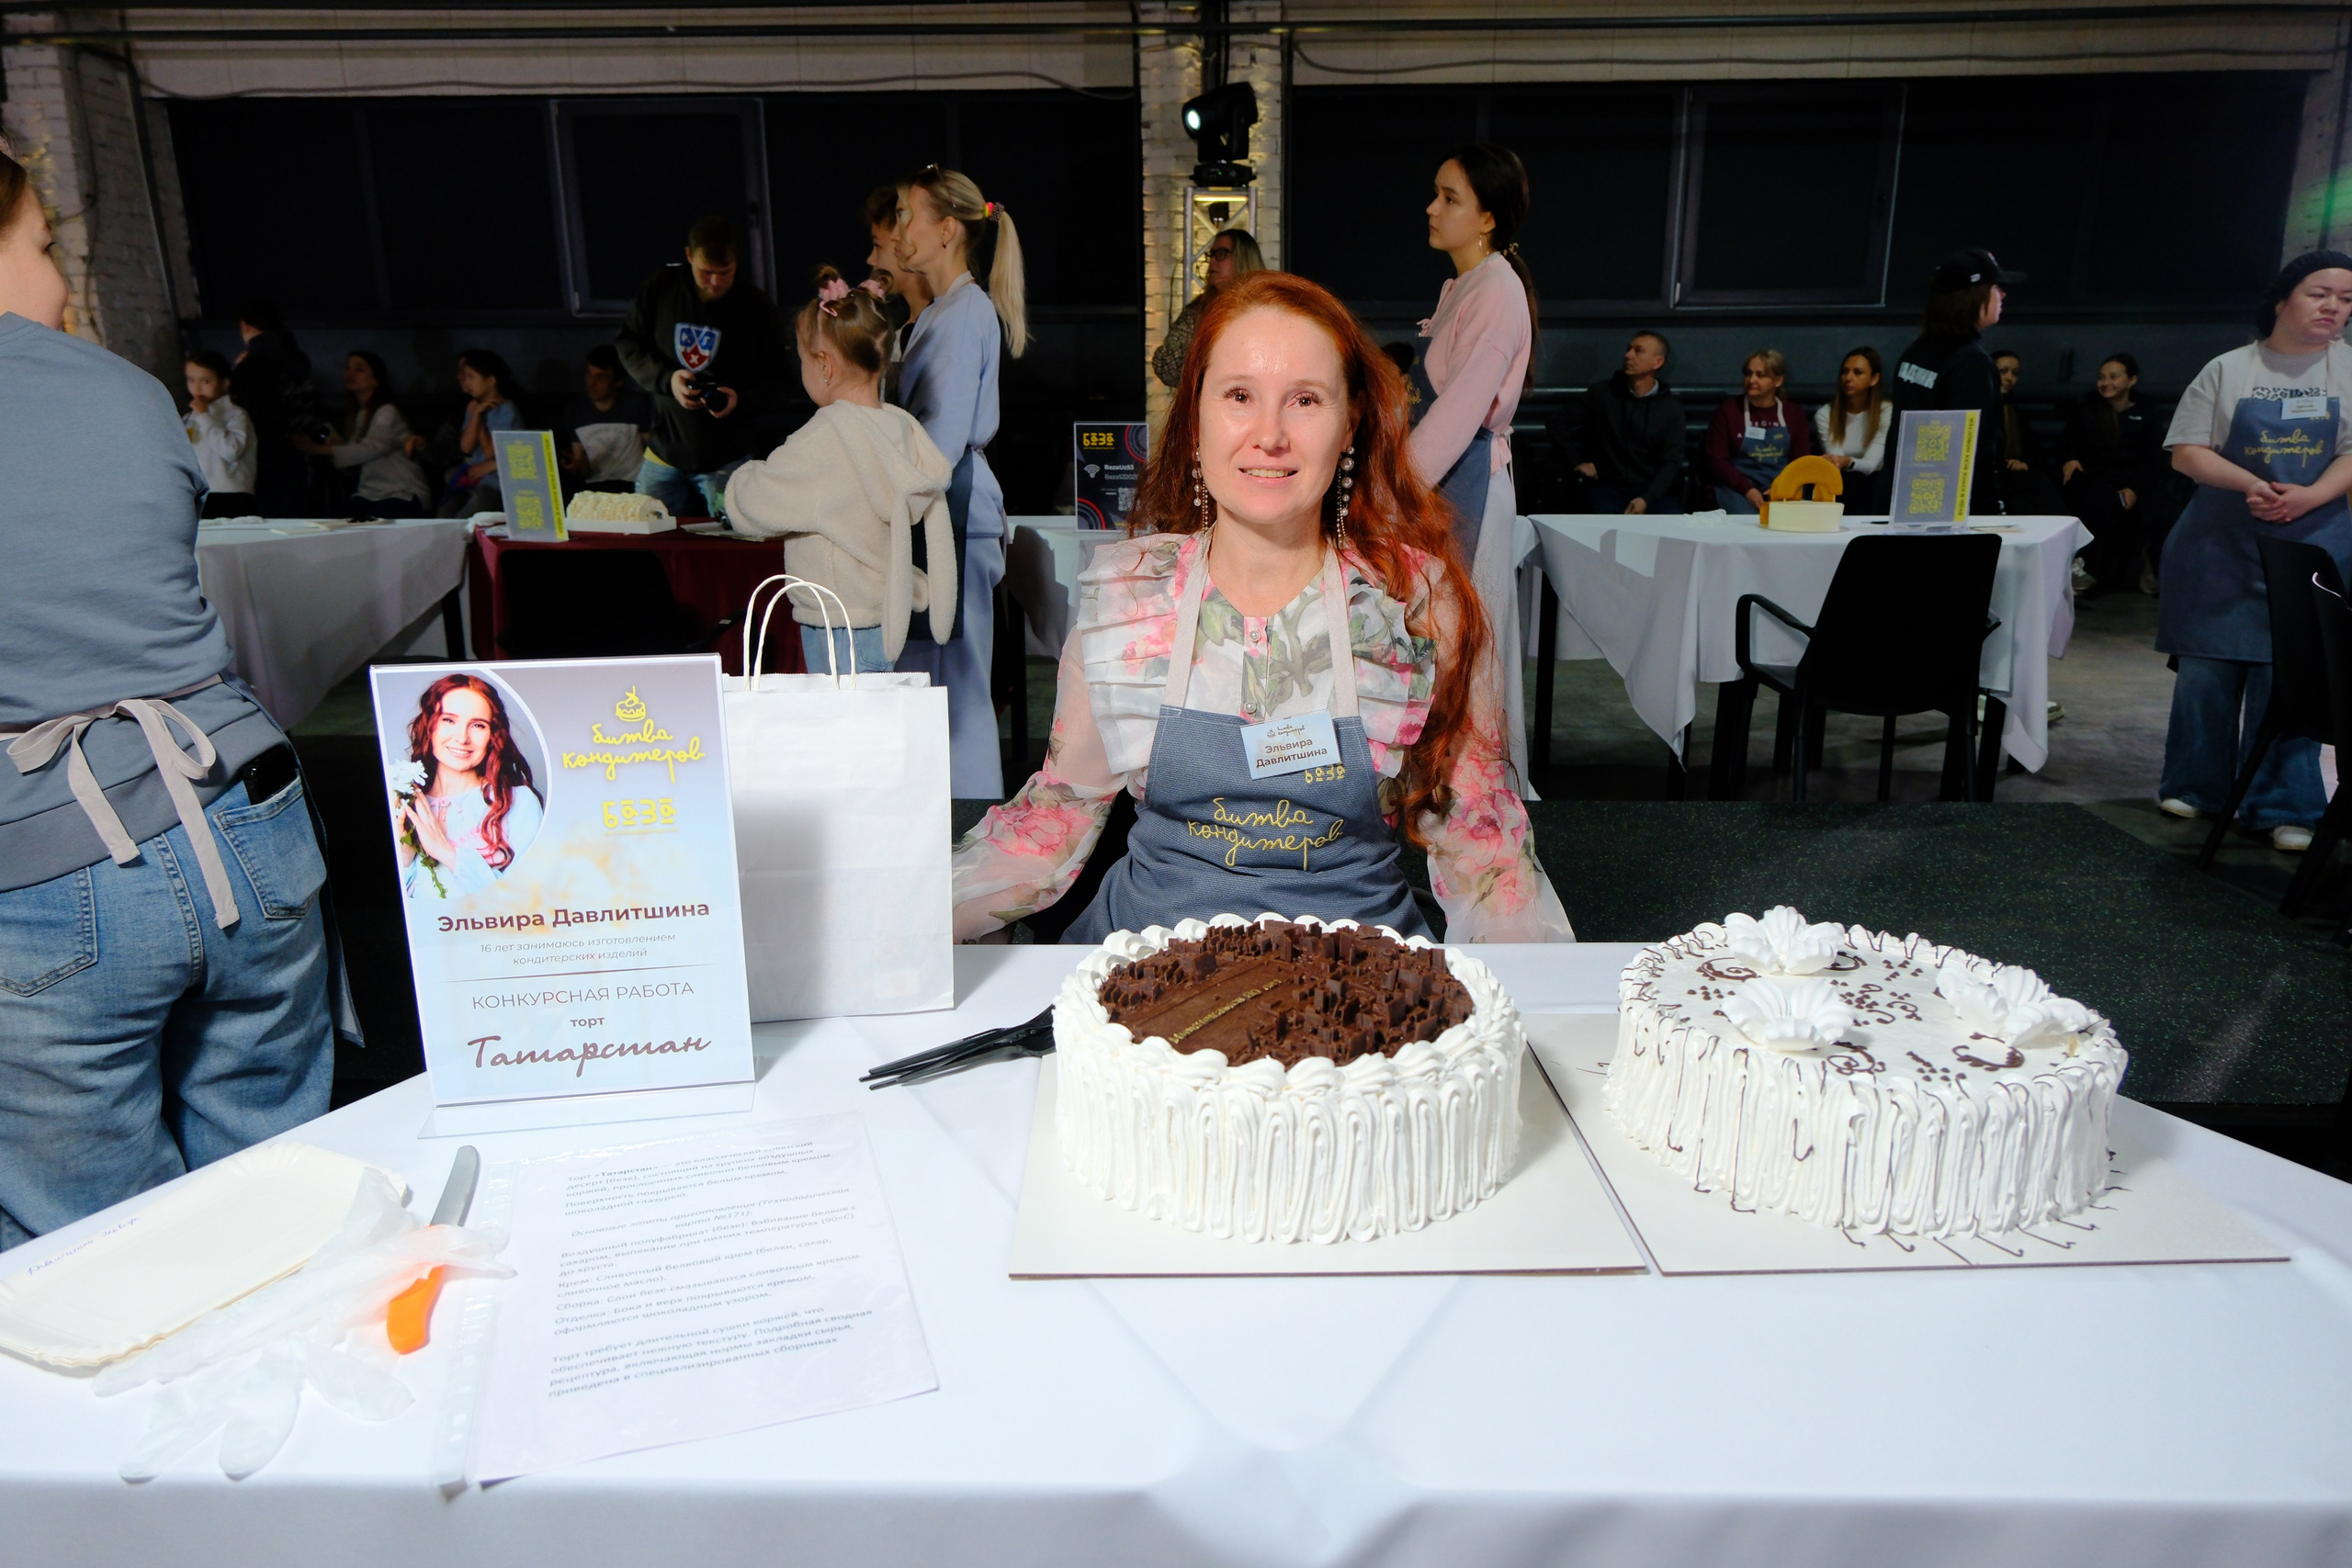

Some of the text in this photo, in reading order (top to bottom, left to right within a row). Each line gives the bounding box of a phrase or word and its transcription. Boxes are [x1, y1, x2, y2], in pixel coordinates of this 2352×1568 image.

[1264, 738, 1313, 755] Эльвира
[1256, 747, 1328, 769] Давлитшина
[437, 901, 710, 932] Эльвира Давлитшина
[480, 932, 676, 953] 16 лет занимаюсь изготовлением
[513, 948, 648, 967] кондитерских изделий
[471, 981, 695, 1010] КОНКУРСНАЯ РАБОТА
[570, 1015, 605, 1029] торт
[467, 1034, 712, 1078] Татарстан
